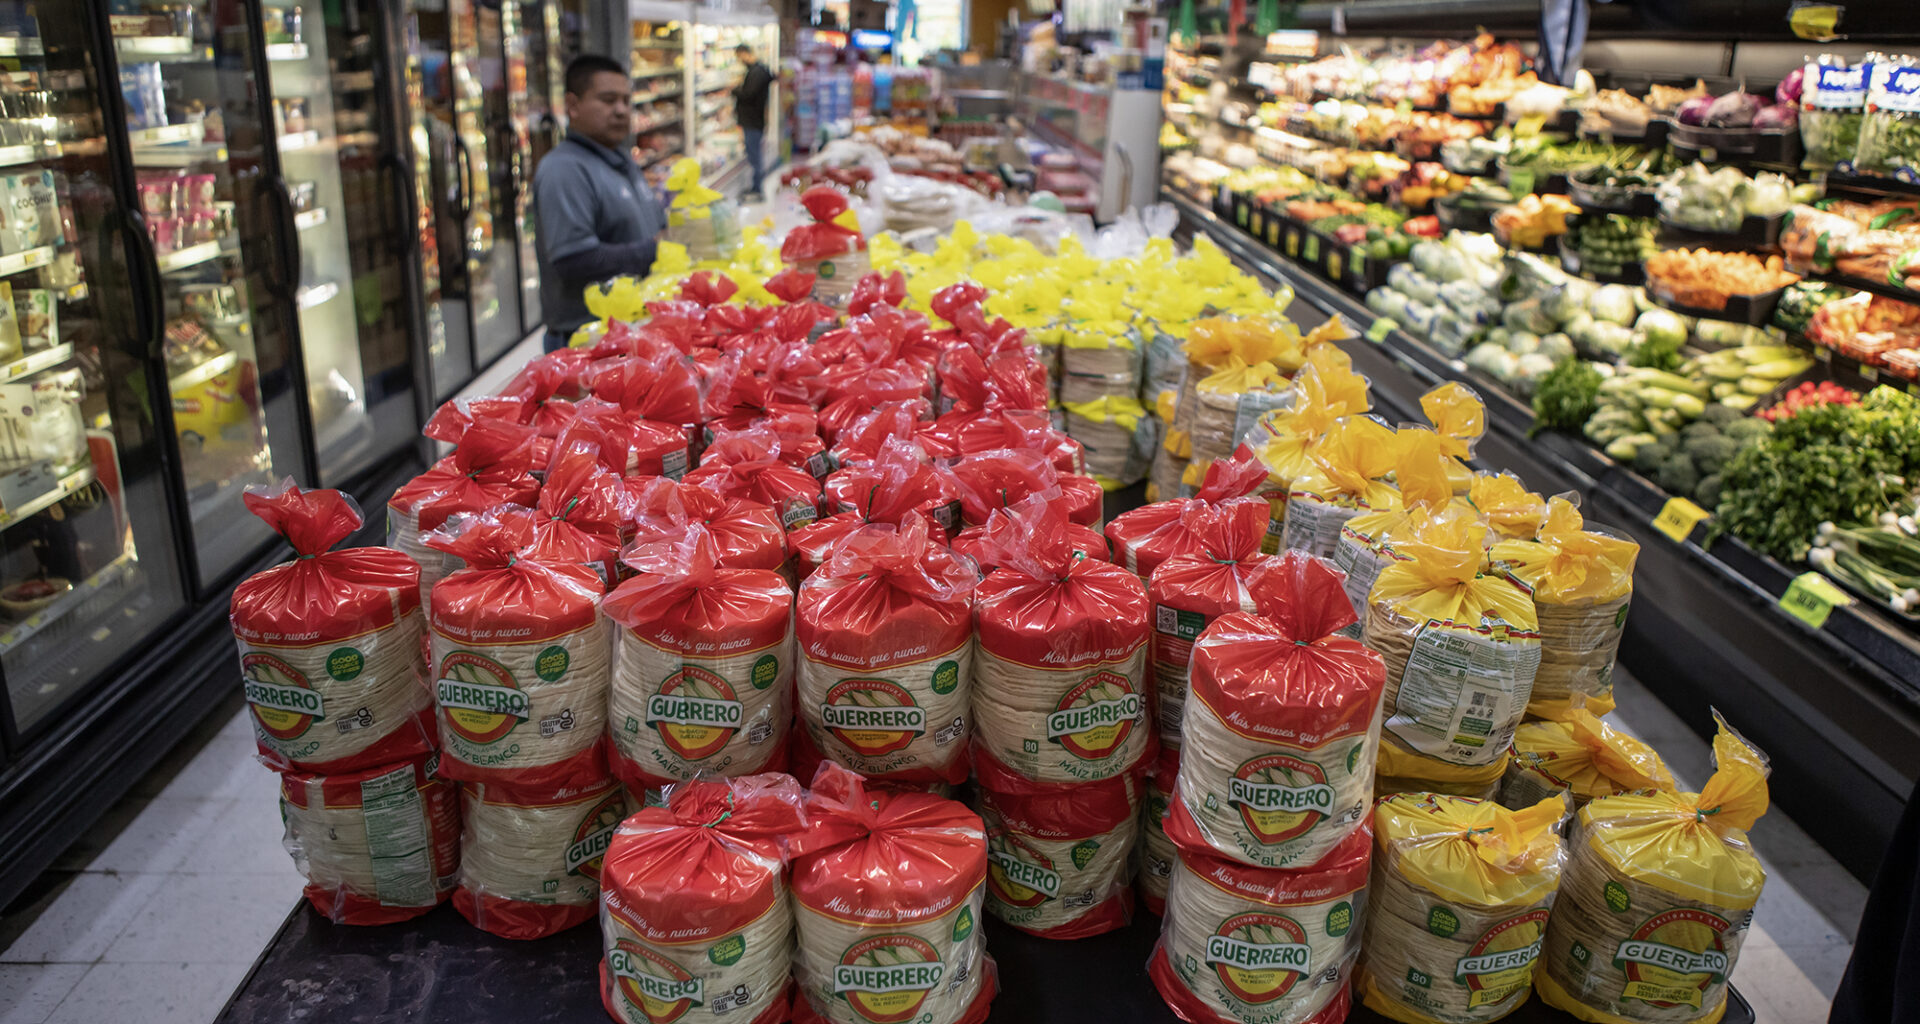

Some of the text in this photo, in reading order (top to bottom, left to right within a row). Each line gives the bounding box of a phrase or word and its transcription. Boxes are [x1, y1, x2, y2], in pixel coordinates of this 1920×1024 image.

[263, 631, 320, 643] que nunca
[471, 628, 492, 641] que
[495, 627, 532, 637] nunca
[695, 642, 716, 653] que
[719, 638, 752, 649] nunca
[331, 654, 358, 665] GOOD
[540, 652, 565, 665] GOOD
[810, 642, 928, 667] Más suaves que nunca
[1040, 651, 1066, 663] Más
[1104, 648, 1124, 658] que
[755, 662, 775, 673] GOOD
[438, 682, 524, 710] GUERRERO
[866, 682, 903, 697] FRESCURA
[1069, 678, 1095, 699] CALIDAD
[823, 707, 921, 726] GUERRERO
[1051, 697, 1138, 731] GUERRERO
[1226, 710, 1249, 729] Más
[1253, 723, 1296, 738] suaves
[472, 743, 520, 765] BLANCO
[1025, 741, 1037, 752] 80
[652, 748, 680, 776] MAÍZ
[868, 754, 917, 774] BLANCO
[1060, 759, 1088, 779] MAÍZ
[1246, 758, 1278, 772] CALIDAD
[552, 788, 577, 800] Más
[1232, 780, 1331, 808] GUERRERO
[1037, 828, 1069, 837] nunca
[1233, 830, 1260, 860] MAÍZ
[545, 881, 558, 890] 80
[1211, 866, 1235, 886] Más
[1236, 880, 1275, 896] suaves
[1278, 890, 1299, 902] que
[1607, 885, 1627, 900] GOOD
[602, 889, 621, 909] Más
[622, 905, 647, 929] suaves
[648, 926, 666, 938] que
[669, 927, 711, 938] nunca
[824, 896, 851, 915] Más
[922, 896, 952, 916] nunca
[1229, 916, 1258, 928] CALIDAD
[1330, 908, 1350, 921] GOOD
[1433, 910, 1457, 924] GOOD
[1650, 912, 1692, 928] CALIDAD
[1483, 919, 1520, 943] CALIDAD
[852, 939, 881, 956] CALIDAD
[891, 938, 927, 953] FRESCURA
[1210, 939, 1307, 966] GUERRERO
[1574, 946, 1586, 961] 80
[838, 966, 943, 989] GUERRERO
[1412, 972, 1427, 985] 80
[714, 995, 735, 1006] GLUTEN
[715, 1004, 728, 1012] FREE
[1215, 988, 1245, 1016] MAÍZ
